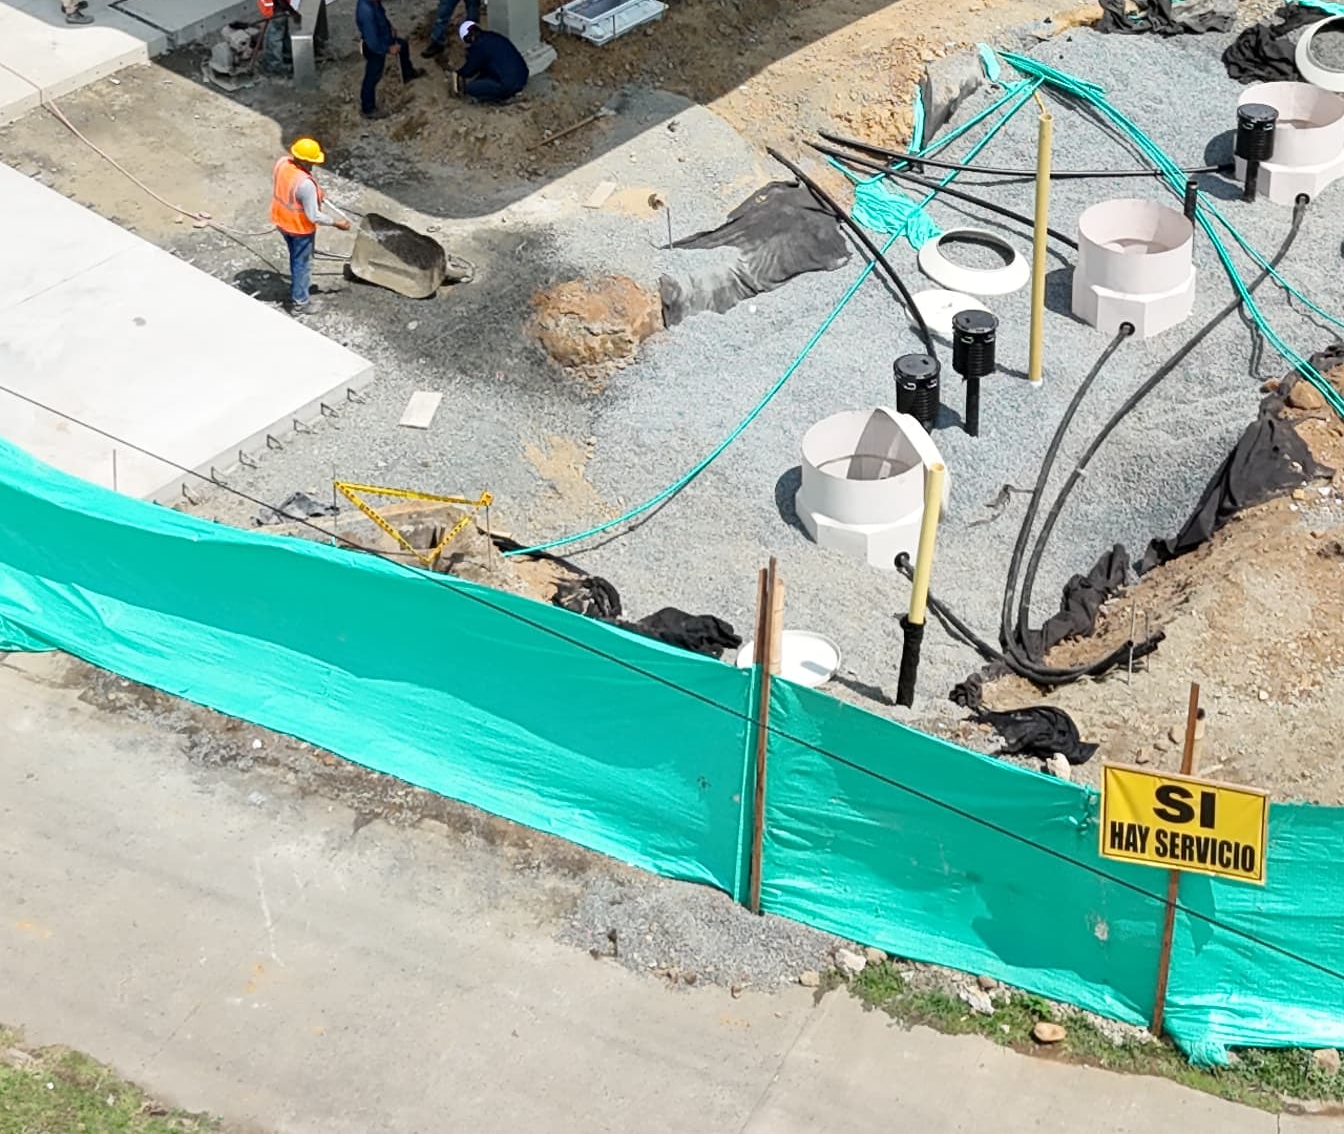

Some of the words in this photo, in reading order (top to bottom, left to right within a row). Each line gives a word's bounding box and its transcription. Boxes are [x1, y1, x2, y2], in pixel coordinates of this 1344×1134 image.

[1152, 784, 1217, 830] SI
[1109, 820, 1151, 854] HAY
[1154, 828, 1256, 873] SERVICIO
